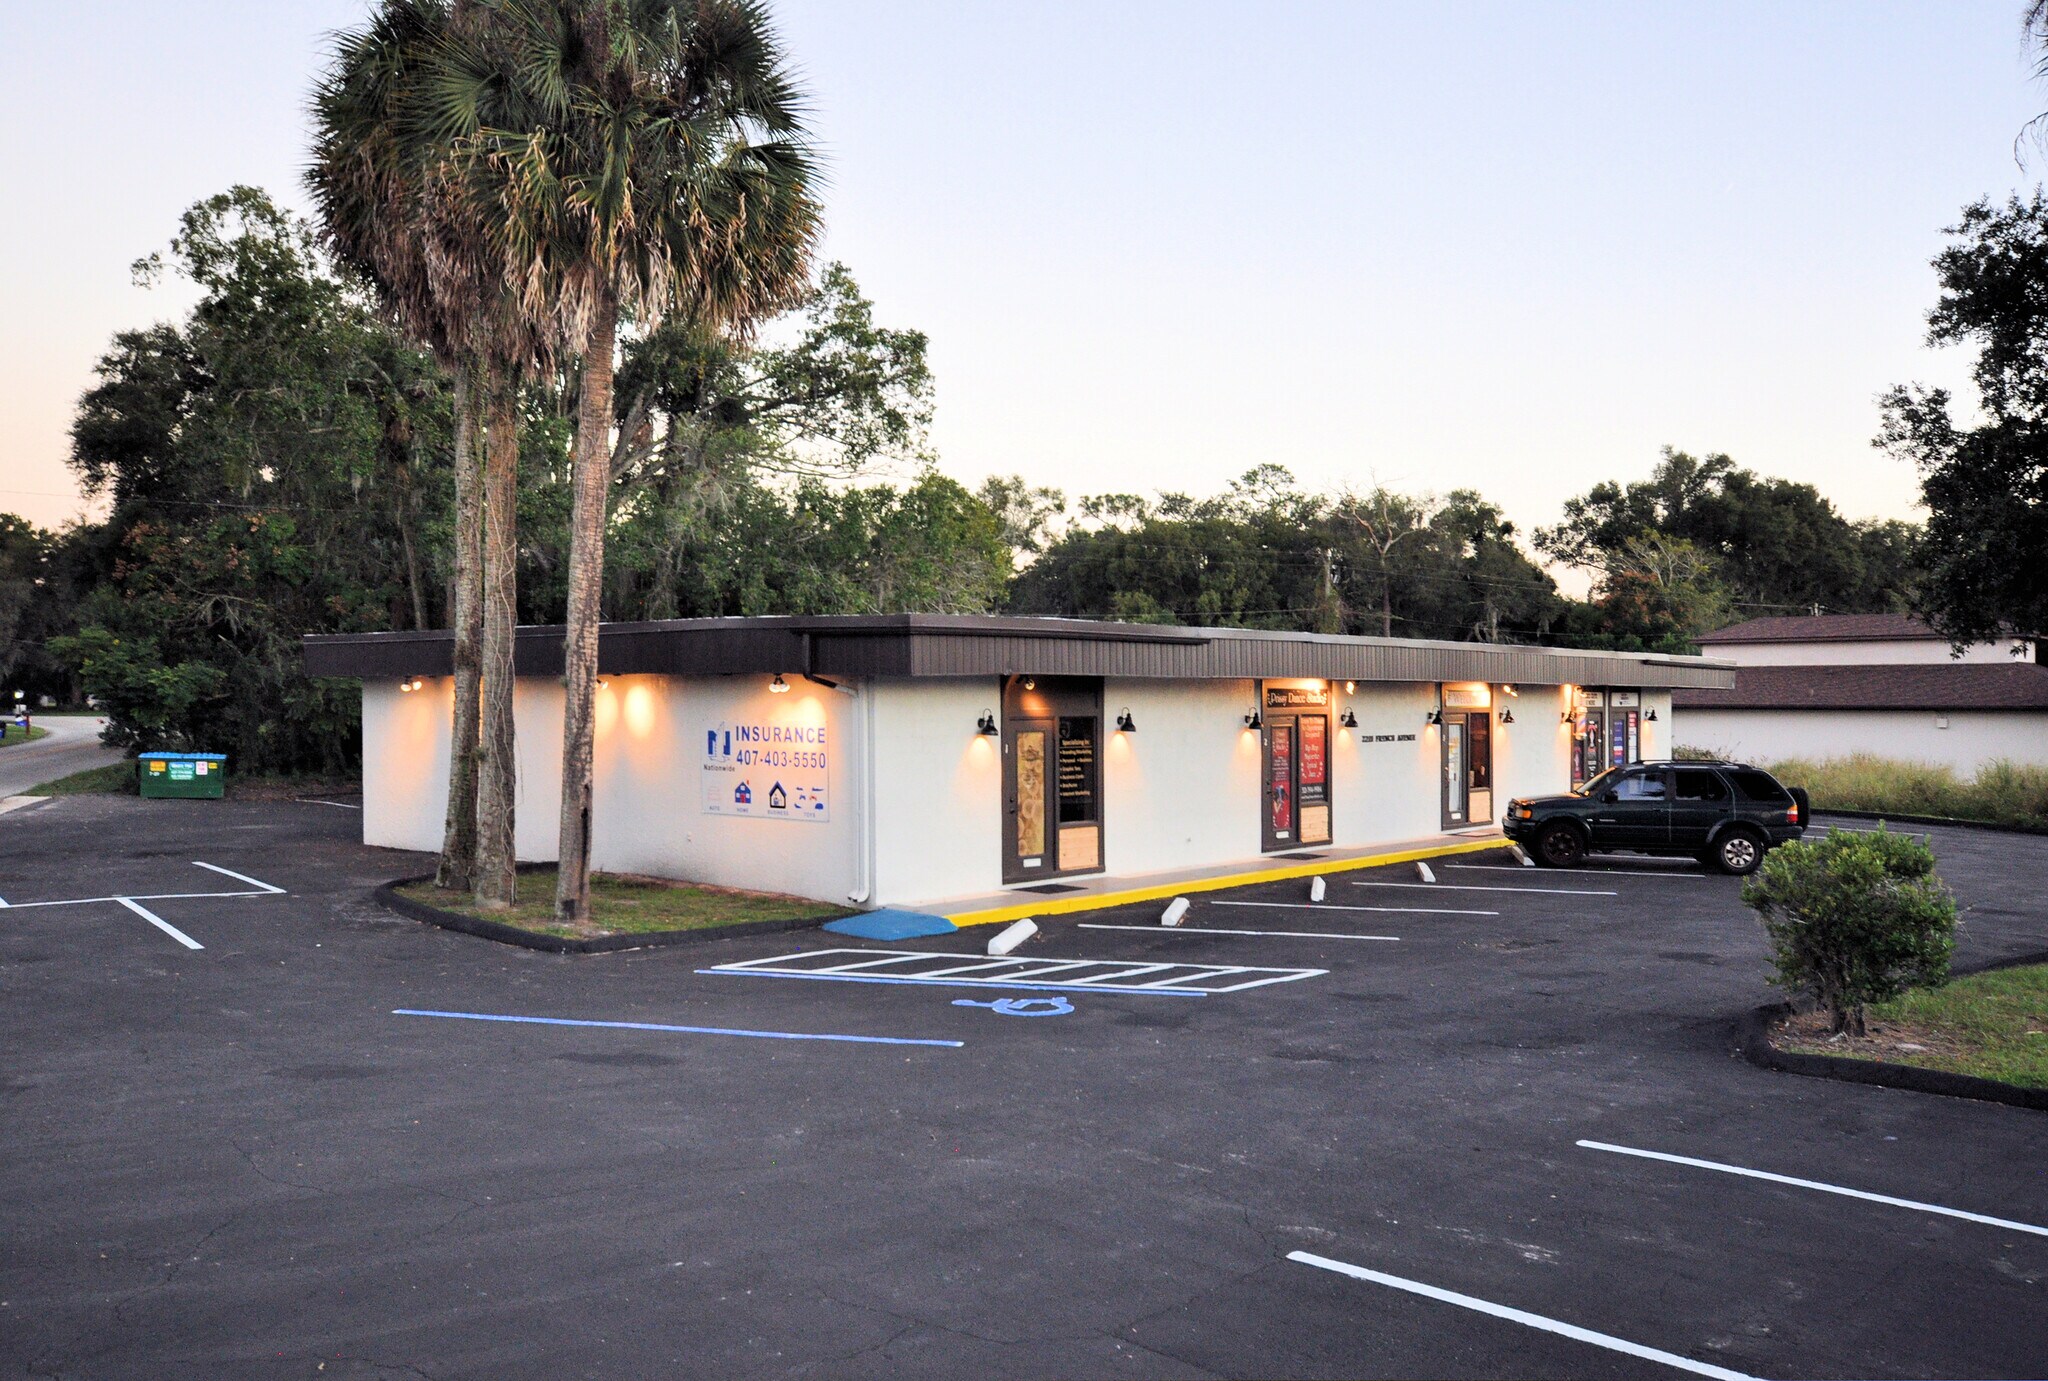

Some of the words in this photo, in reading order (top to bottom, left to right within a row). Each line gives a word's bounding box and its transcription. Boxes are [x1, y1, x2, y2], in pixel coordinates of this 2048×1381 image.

[1288, 692, 1305, 703] Dance
[736, 726, 826, 743] INSURANCE
[1264, 738, 1268, 746] 2
[736, 750, 826, 768] 407-403-5550
[703, 764, 735, 772] Nationwide
